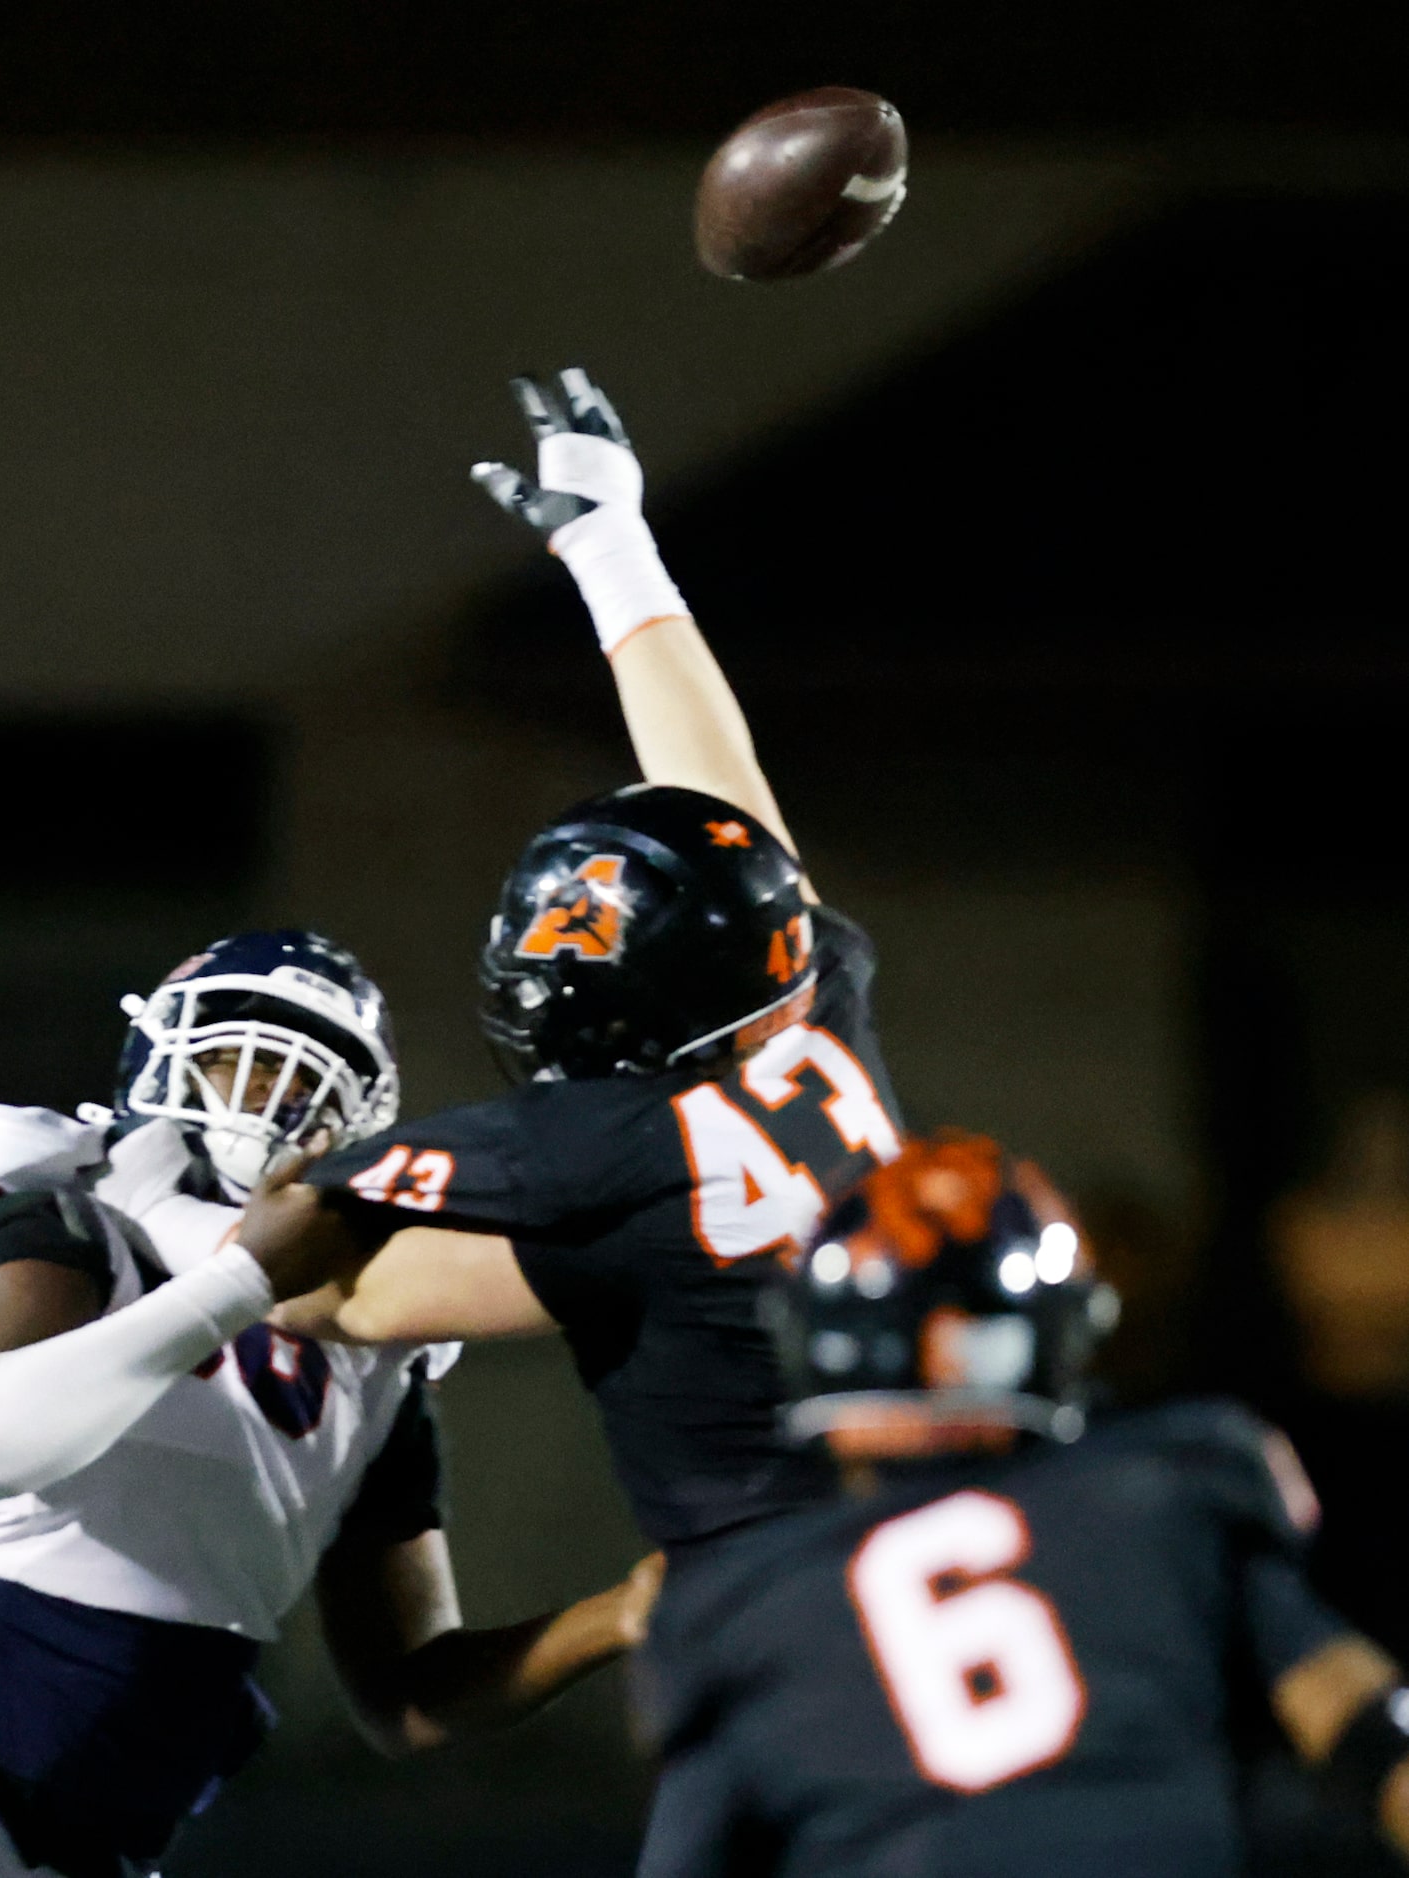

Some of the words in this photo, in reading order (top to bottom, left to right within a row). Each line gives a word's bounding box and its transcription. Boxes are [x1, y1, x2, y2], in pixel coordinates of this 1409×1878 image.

[348, 1143, 456, 1213] 43
[669, 1020, 903, 1270] 43
[844, 1489, 1087, 1794] 6
